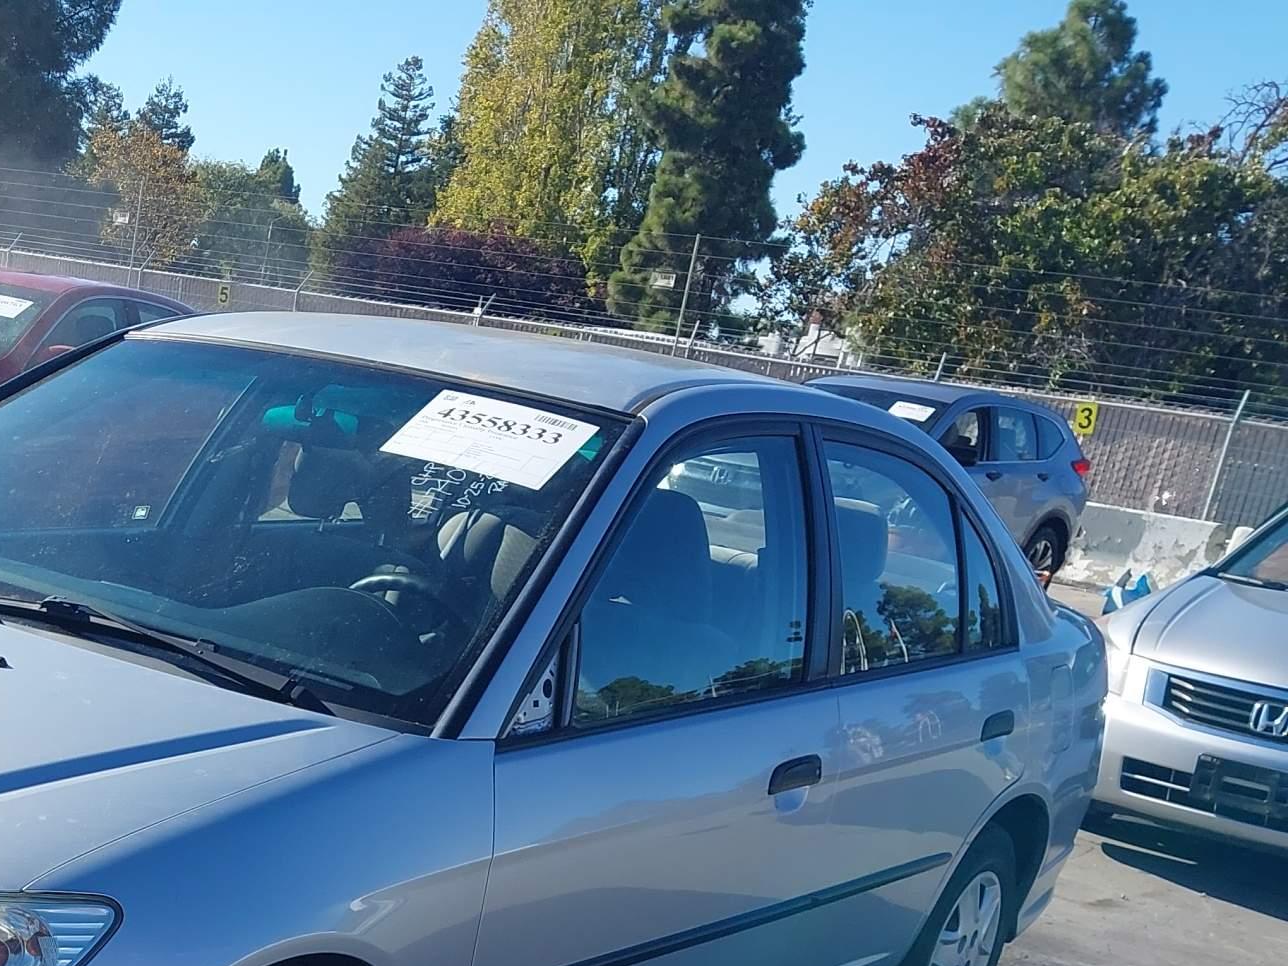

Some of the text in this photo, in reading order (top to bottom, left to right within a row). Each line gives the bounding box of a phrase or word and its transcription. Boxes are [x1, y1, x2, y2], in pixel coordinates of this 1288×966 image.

[219, 286, 229, 304] 5
[437, 407, 564, 445] 43558333
[1077, 406, 1094, 429] 3
